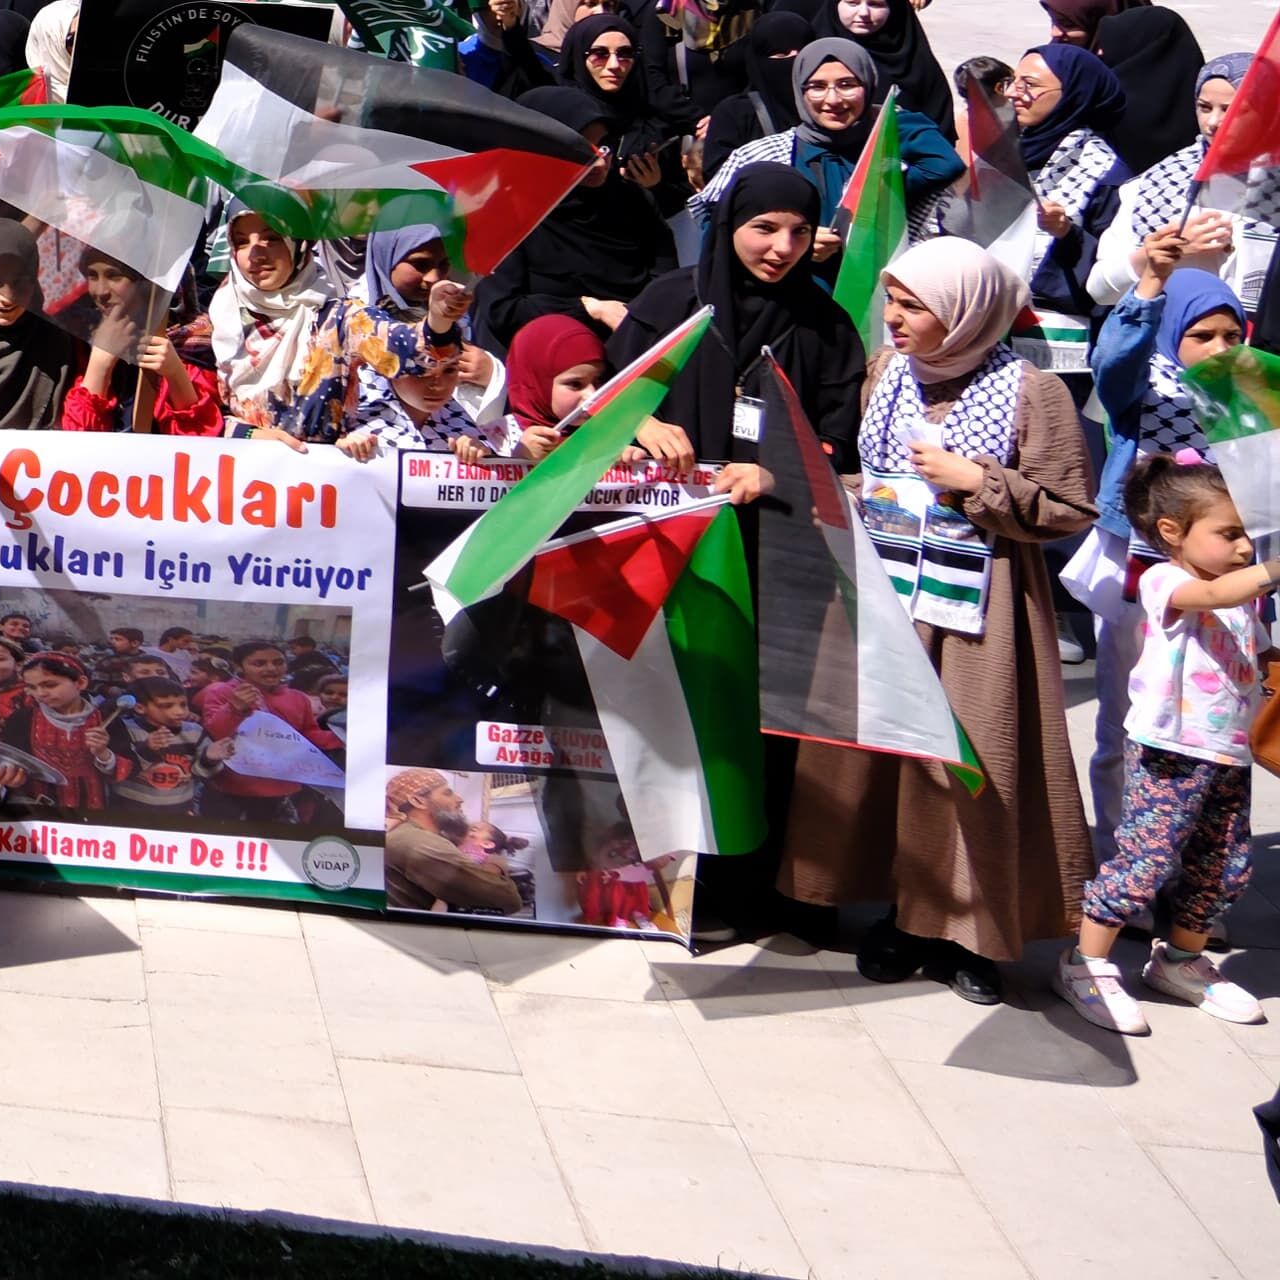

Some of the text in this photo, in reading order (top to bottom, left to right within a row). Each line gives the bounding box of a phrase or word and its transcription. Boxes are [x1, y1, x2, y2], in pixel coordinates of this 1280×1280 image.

[409, 459, 431, 477] BM
[444, 461, 452, 479] 7
[437, 484, 466, 502] HER
[470, 486, 485, 502] 10
[626, 485, 680, 507] ÖLÜYOR
[145, 540, 212, 590] İçin
[228, 551, 372, 599] Yürüyor
[488, 724, 545, 745] Gazze
[496, 746, 555, 765] Ayağa
[129, 832, 179, 865] Dur
[190, 838, 225, 869] De
[236, 841, 269, 872] !!!
